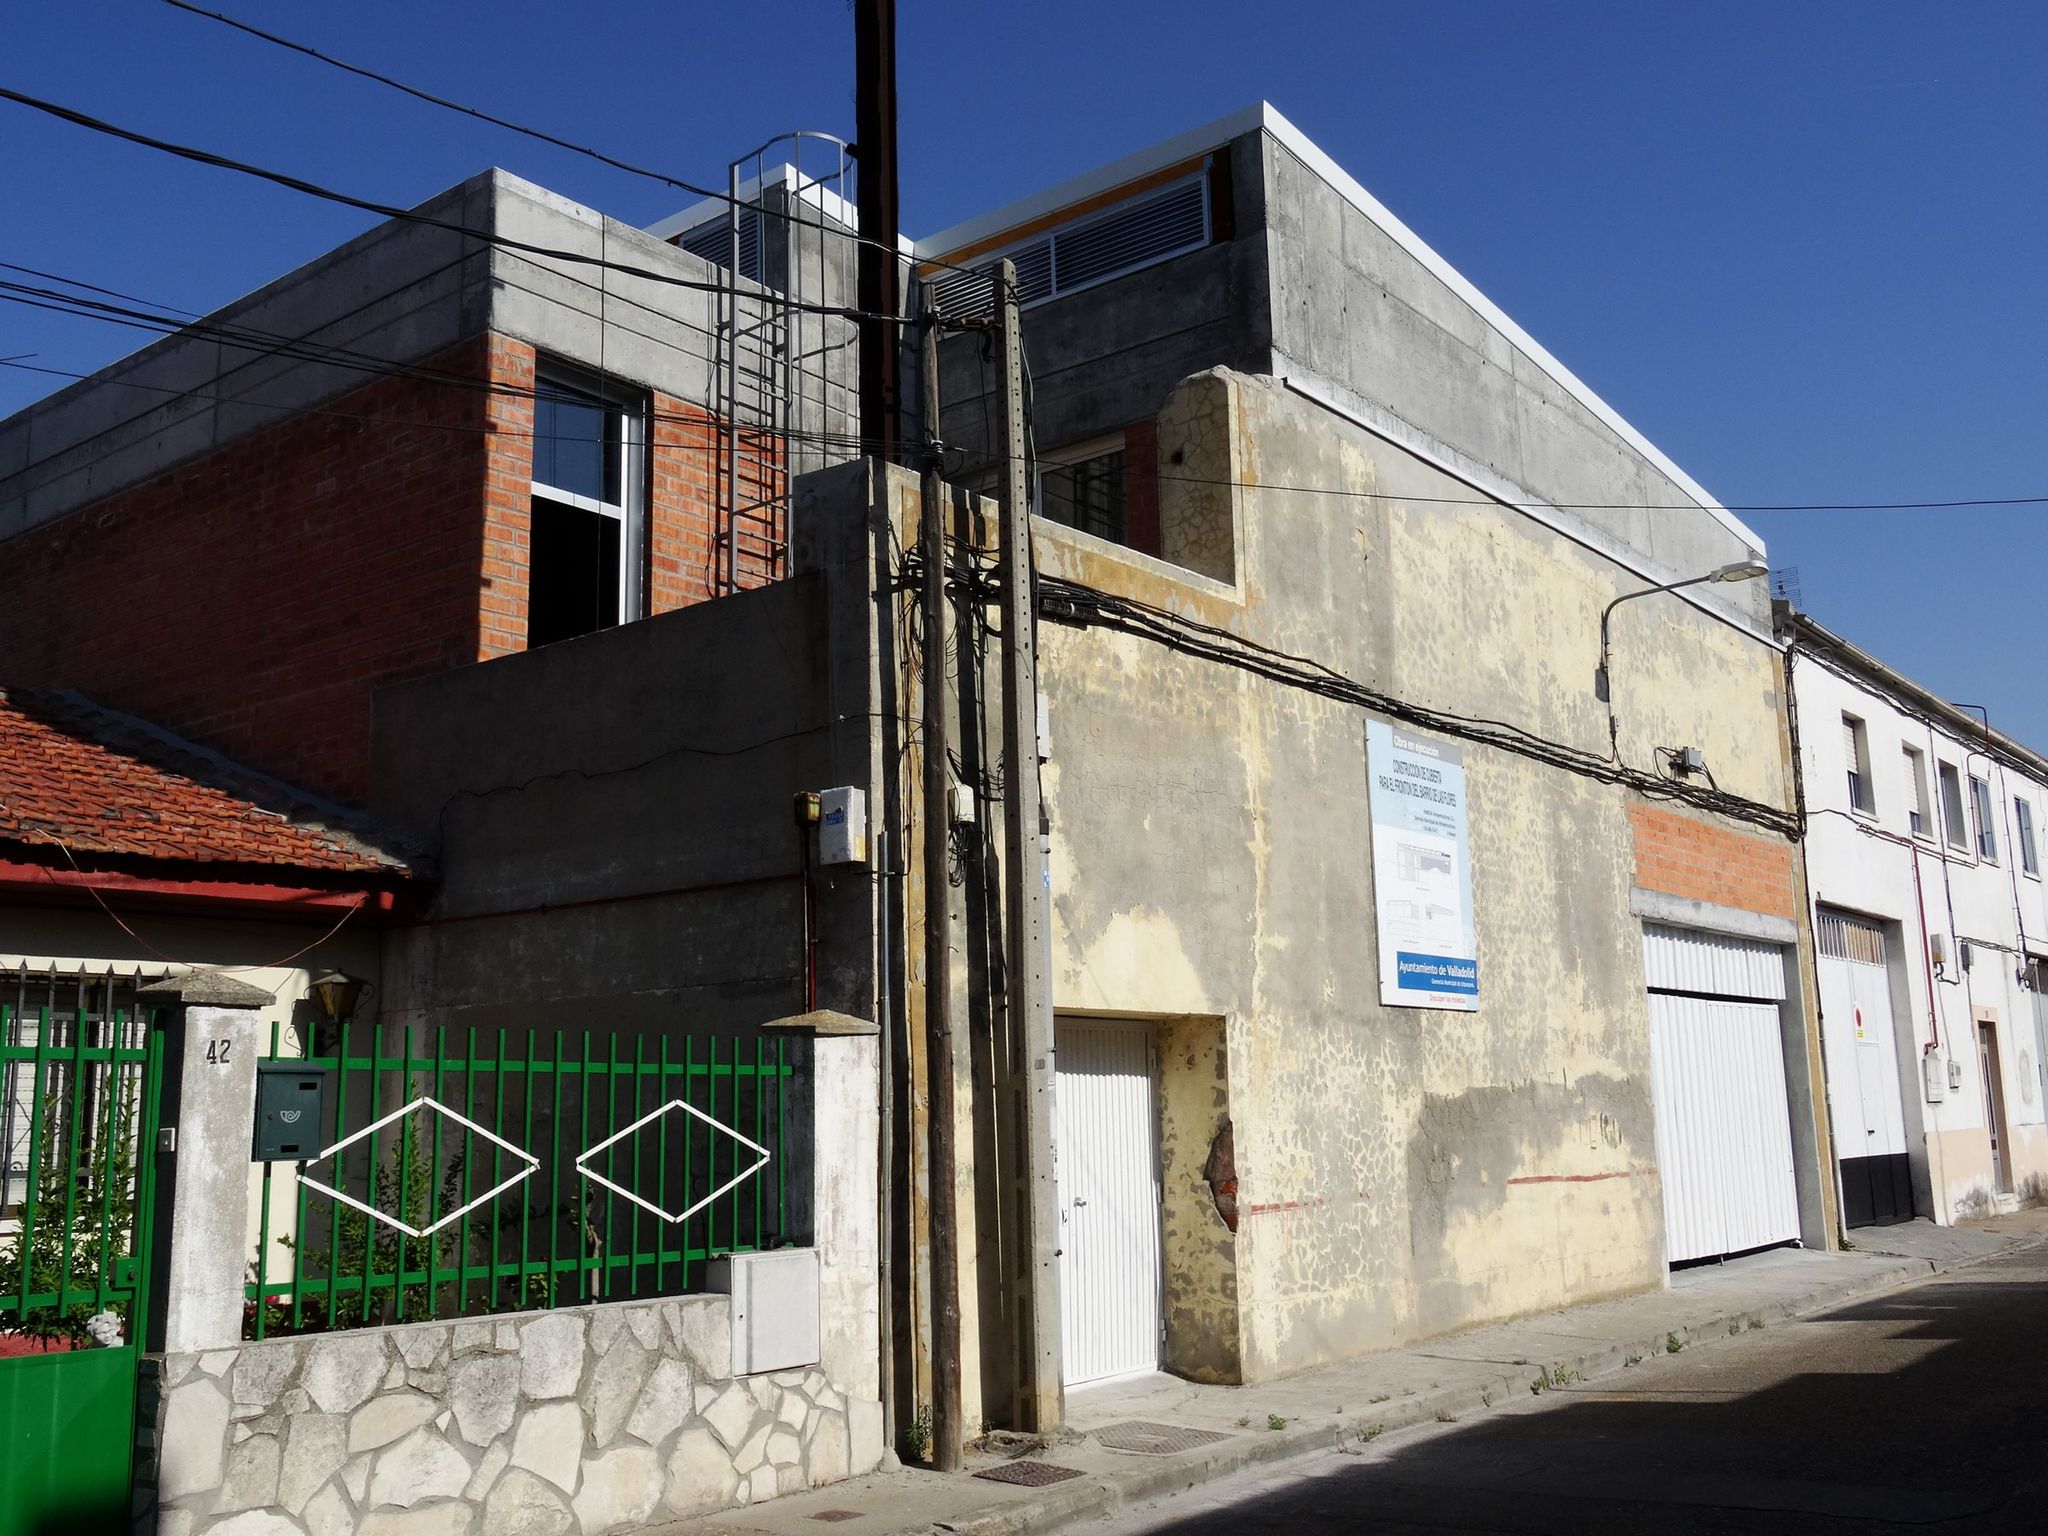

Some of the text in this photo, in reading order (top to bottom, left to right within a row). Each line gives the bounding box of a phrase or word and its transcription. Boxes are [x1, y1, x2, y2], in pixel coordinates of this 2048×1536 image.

[1393, 735, 1407, 749] Obra
[1399, 961, 1475, 979] Ayuntamiento de Valladolid
[206, 1039, 231, 1065] 42
